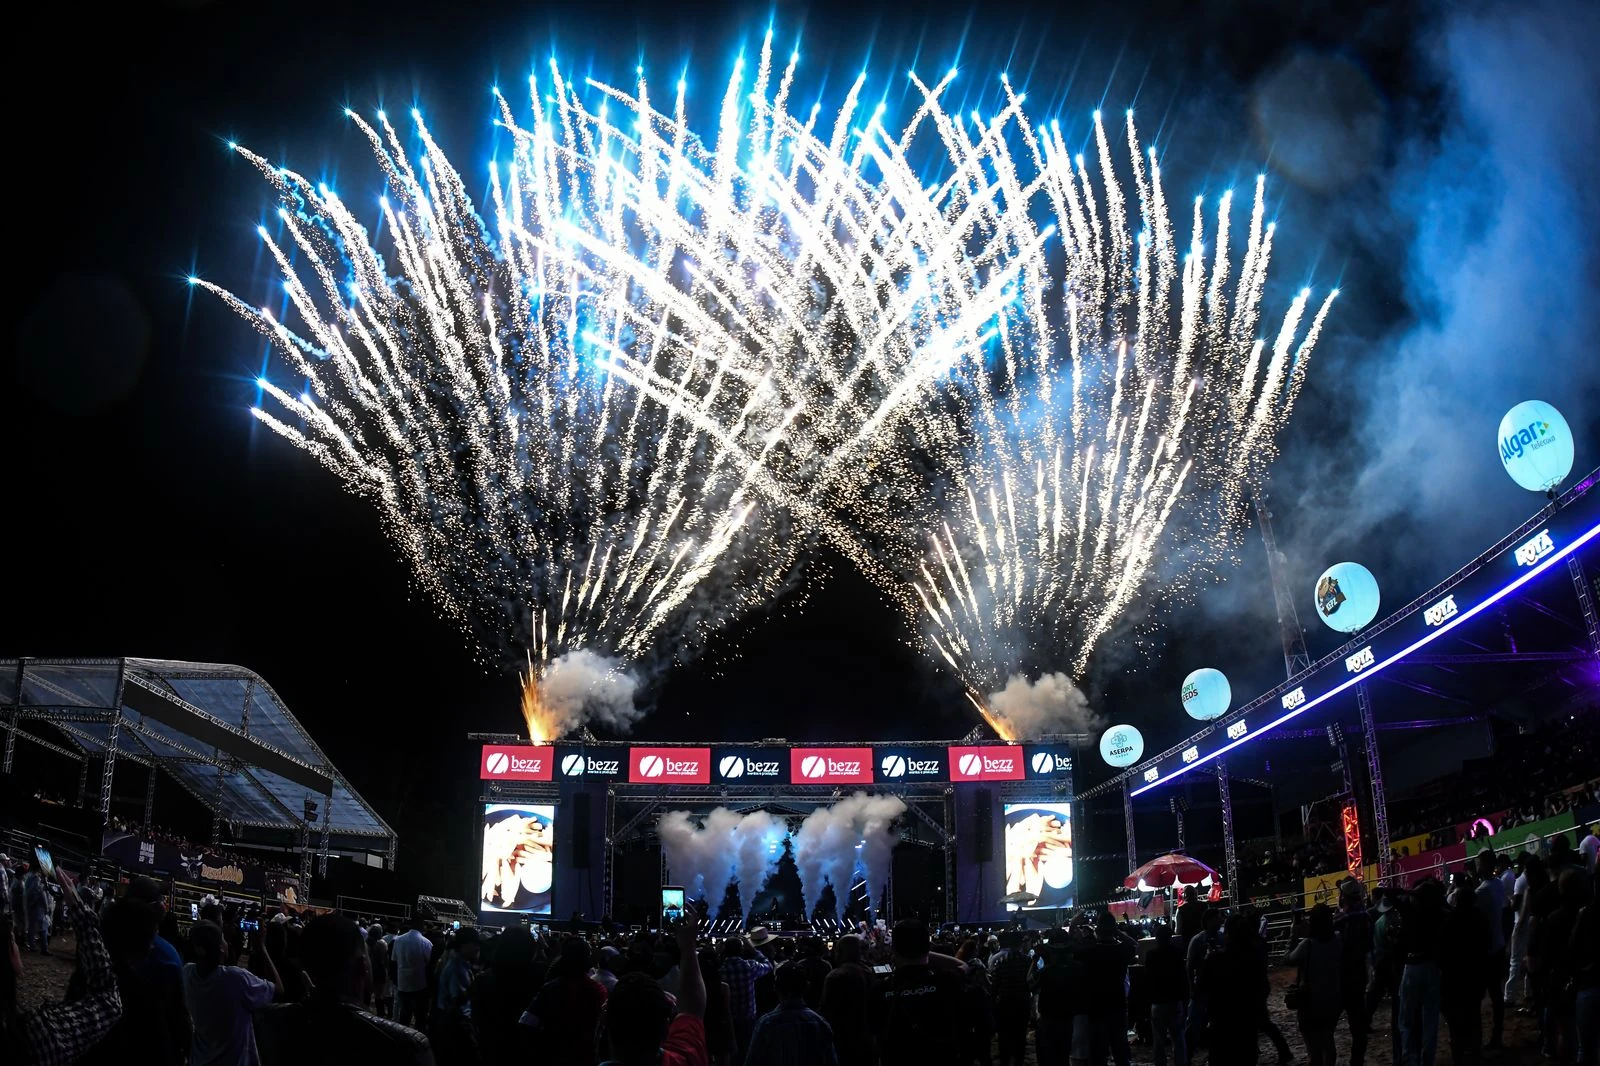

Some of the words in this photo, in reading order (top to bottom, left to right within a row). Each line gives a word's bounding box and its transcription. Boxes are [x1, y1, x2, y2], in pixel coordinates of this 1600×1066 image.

[1501, 423, 1538, 464] Algar
[1182, 682, 1194, 693] ORT
[1110, 746, 1133, 756] ASERPA
[511, 756, 541, 770] bezz
[588, 757, 618, 770] bezz
[666, 758, 698, 772] bezz
[747, 758, 779, 772] bezz
[828, 758, 860, 772] bezz
[908, 758, 939, 770] bezz
[984, 756, 1014, 768] bezz
